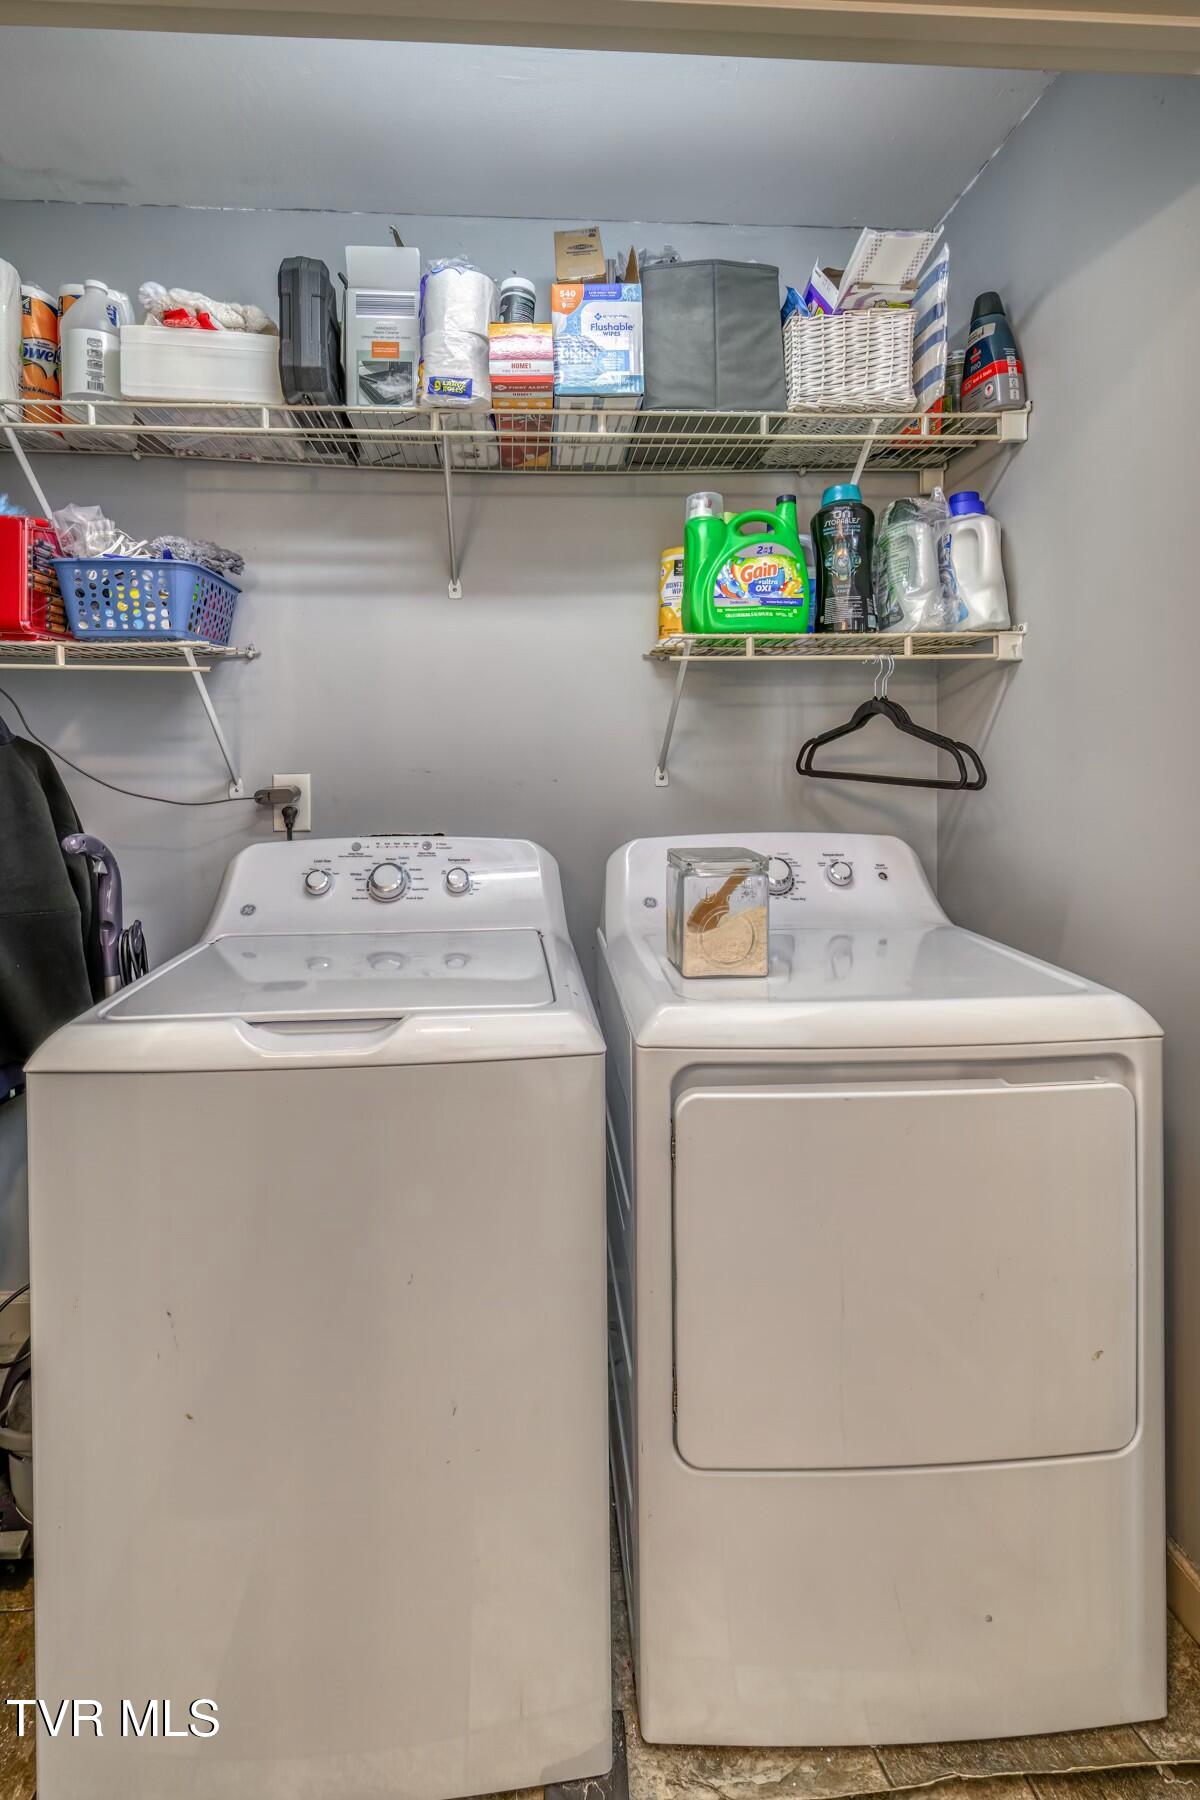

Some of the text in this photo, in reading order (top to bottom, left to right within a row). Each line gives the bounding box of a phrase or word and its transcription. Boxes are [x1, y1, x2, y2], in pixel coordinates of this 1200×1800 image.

[560, 290, 576, 298] 540
[590, 322, 633, 331] Flushable
[740, 562, 778, 583] Gain
